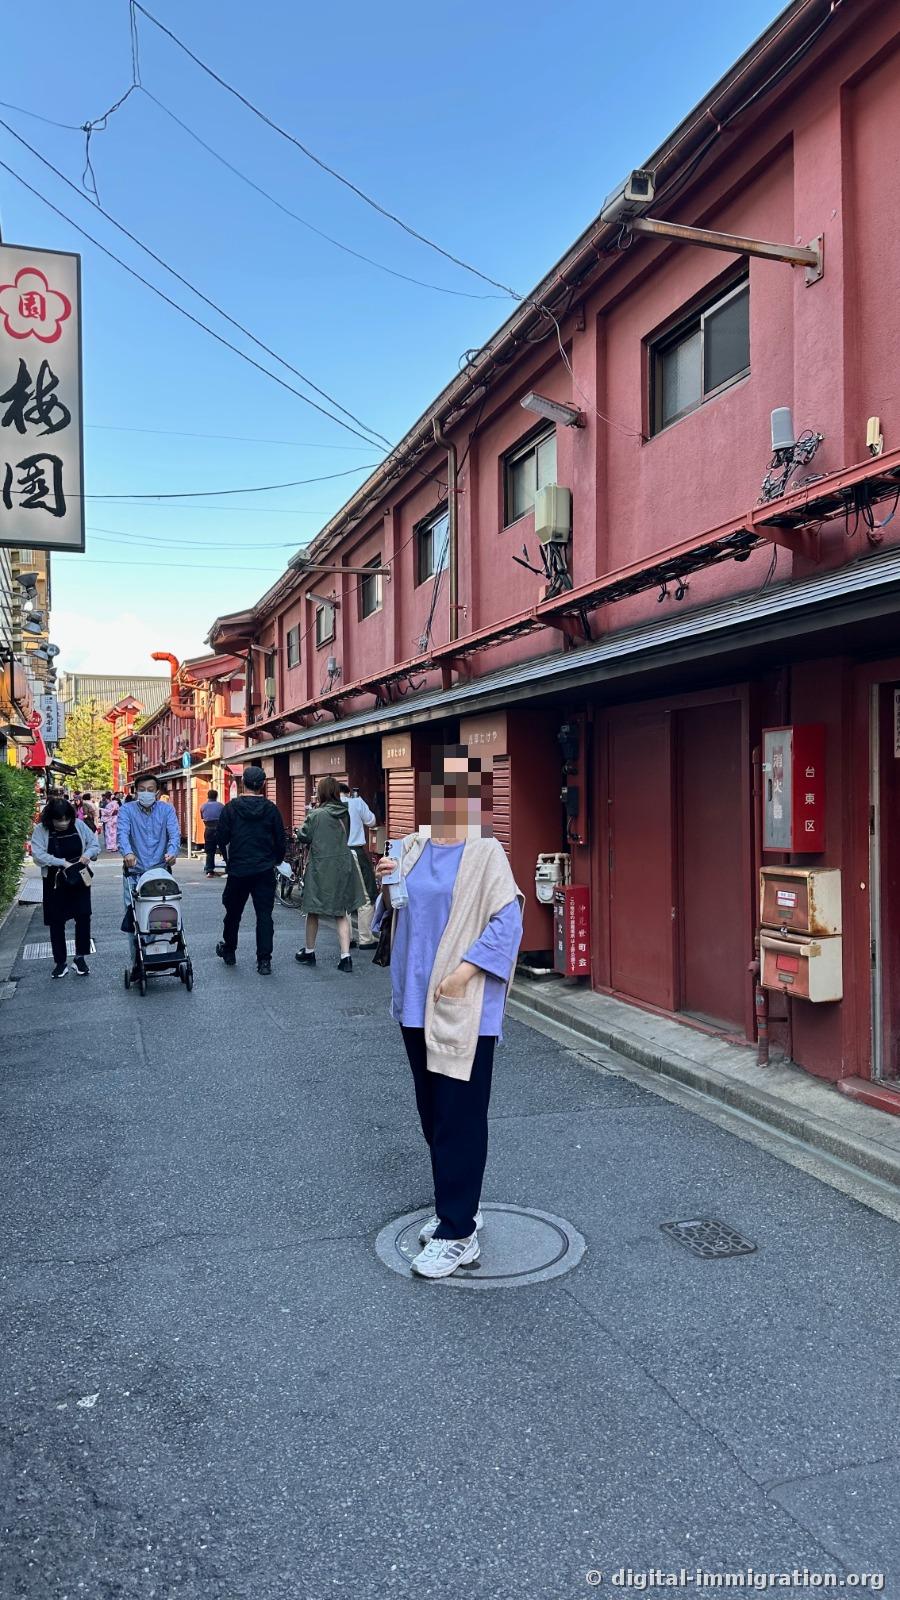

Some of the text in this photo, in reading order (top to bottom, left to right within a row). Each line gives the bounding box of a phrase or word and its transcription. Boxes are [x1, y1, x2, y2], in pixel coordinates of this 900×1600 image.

[18, 291, 46, 322] 園
[0, 357, 71, 517] 梅園
[804, 766, 816, 832] 台東区
